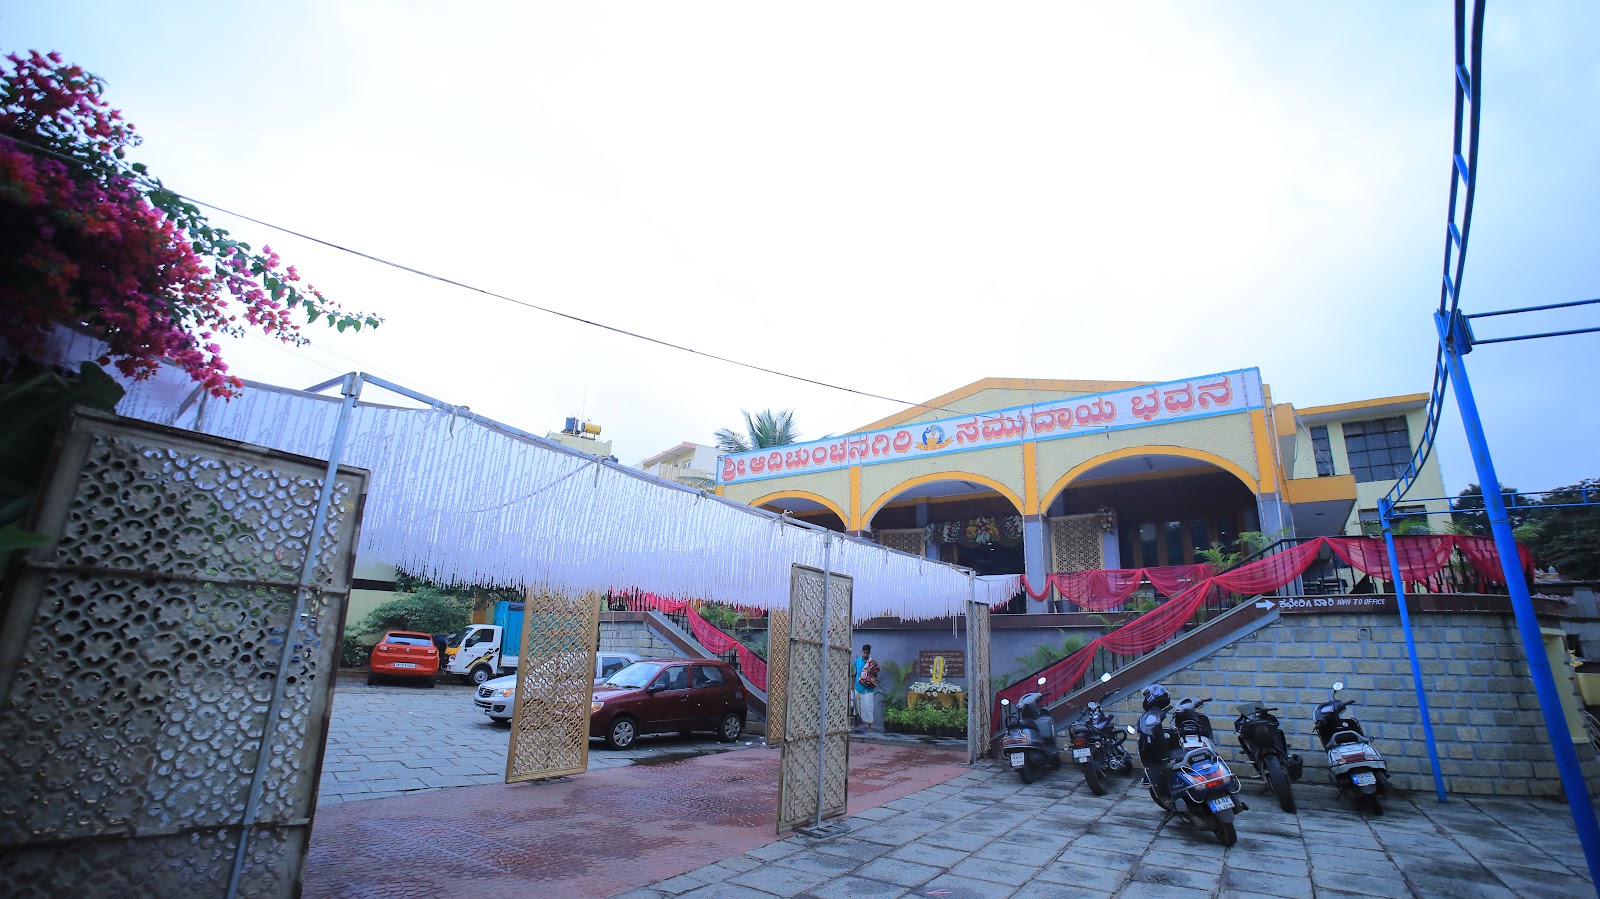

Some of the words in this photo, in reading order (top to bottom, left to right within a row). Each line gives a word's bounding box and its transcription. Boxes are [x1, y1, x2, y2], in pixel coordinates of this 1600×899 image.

[722, 456, 746, 481] ಶ್ರೀ
[750, 430, 914, 474] ಆದಿಚುಂಚನಗಿರಿ
[956, 396, 1117, 445] ಸಮುದಾಯ
[1130, 375, 1234, 422] ಭವನ
